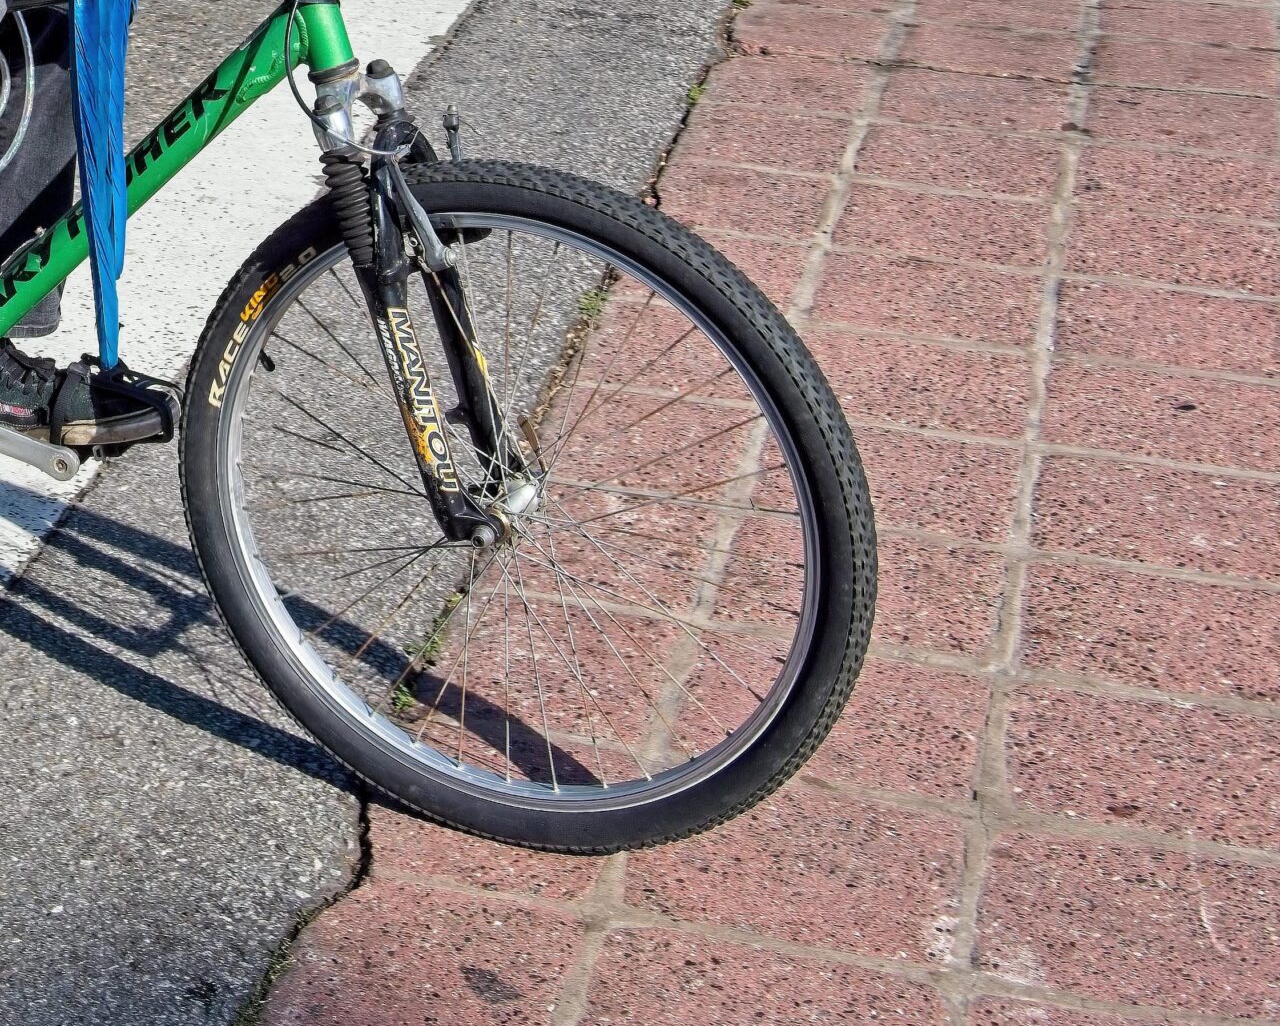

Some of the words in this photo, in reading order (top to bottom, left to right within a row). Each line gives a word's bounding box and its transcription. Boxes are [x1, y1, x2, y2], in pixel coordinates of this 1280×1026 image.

[65, 74, 232, 241] FHER
[208, 321, 251, 409] RACE
[239, 272, 281, 322] KING
[387, 308, 460, 493] MANITOU
